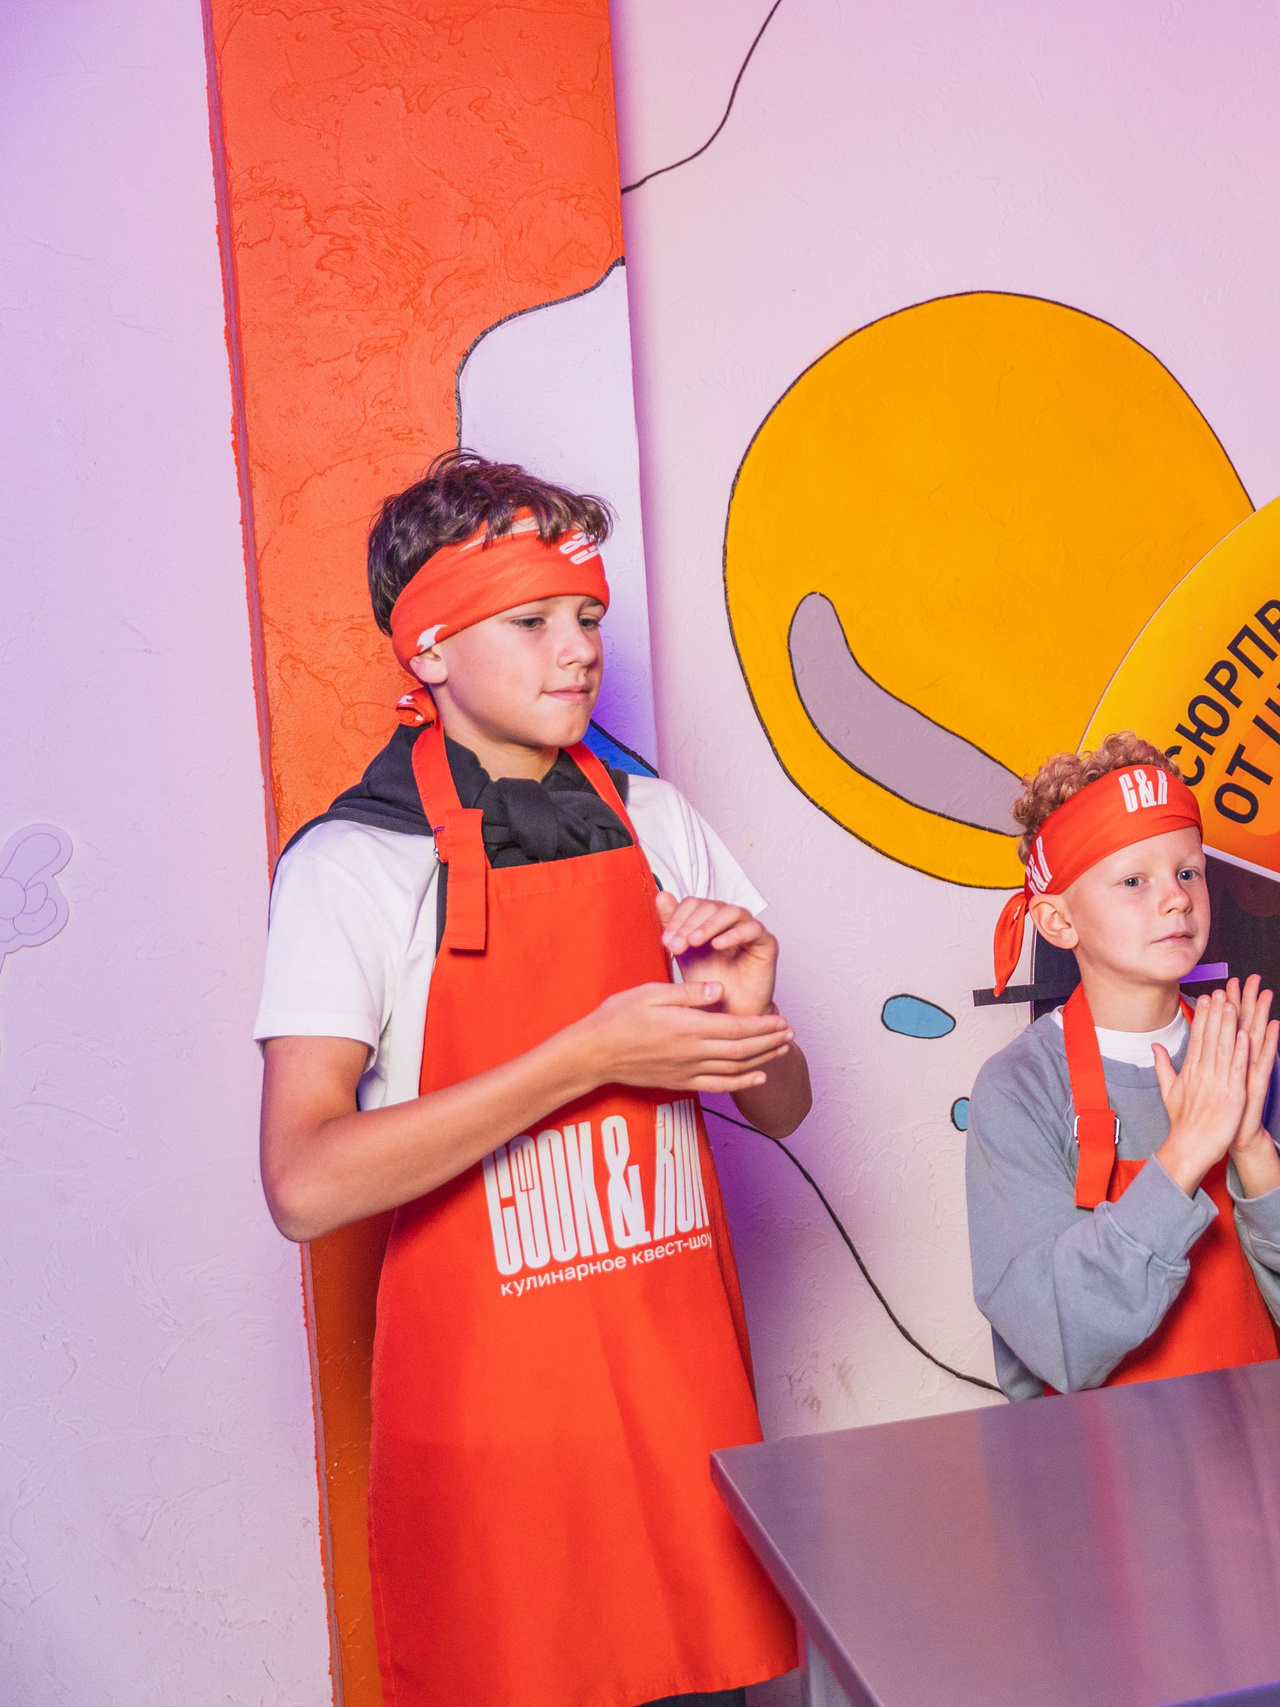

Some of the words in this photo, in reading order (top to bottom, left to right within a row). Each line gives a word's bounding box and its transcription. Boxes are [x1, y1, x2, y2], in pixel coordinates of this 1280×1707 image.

[1118, 769, 1168, 813] C&R
[1214, 743, 1273, 824] ОТ
[481, 1121, 610, 1275] COOK
[600, 1114, 652, 1249] &
[501, 1255, 627, 1297] кулинарное
[632, 1232, 713, 1266] квест-шоу
